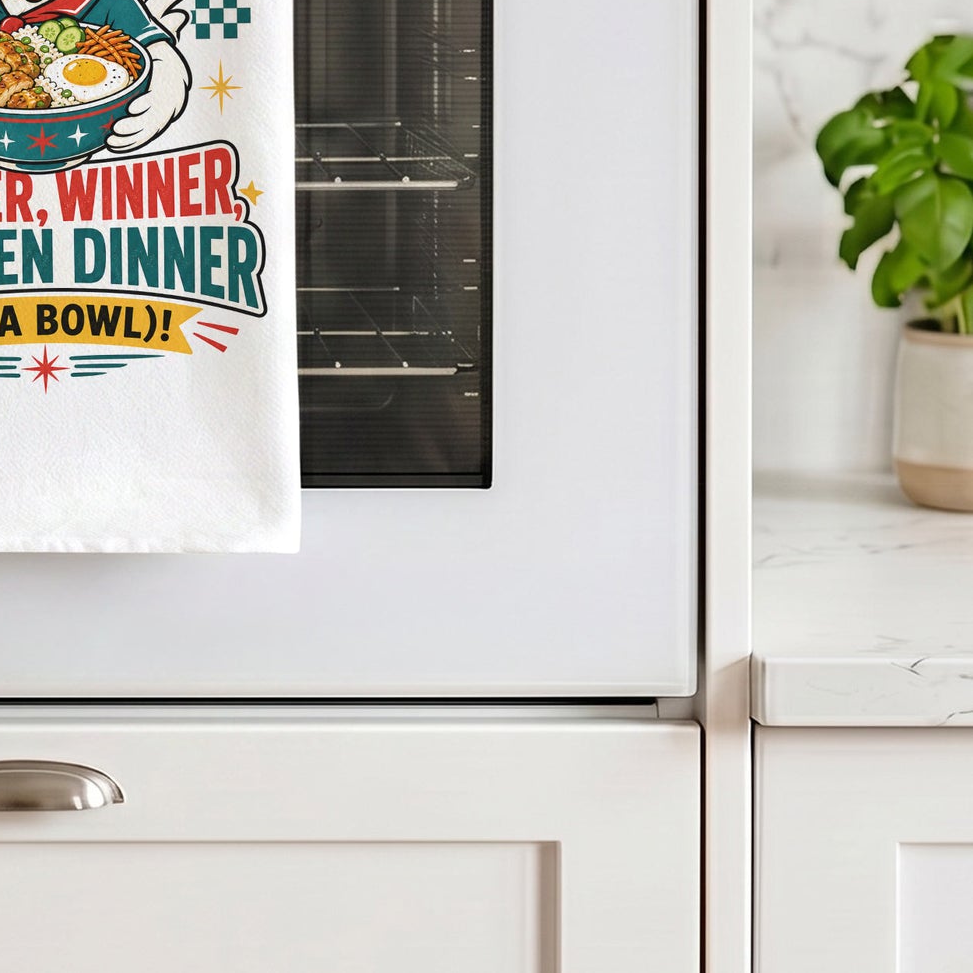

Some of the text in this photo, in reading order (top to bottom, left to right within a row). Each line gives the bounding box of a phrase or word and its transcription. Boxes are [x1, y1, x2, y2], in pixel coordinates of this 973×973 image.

[54, 147, 243, 222] WINNER,
[73, 226, 259, 309] DINNER
[36, 304, 173, 343] BOWL)!
